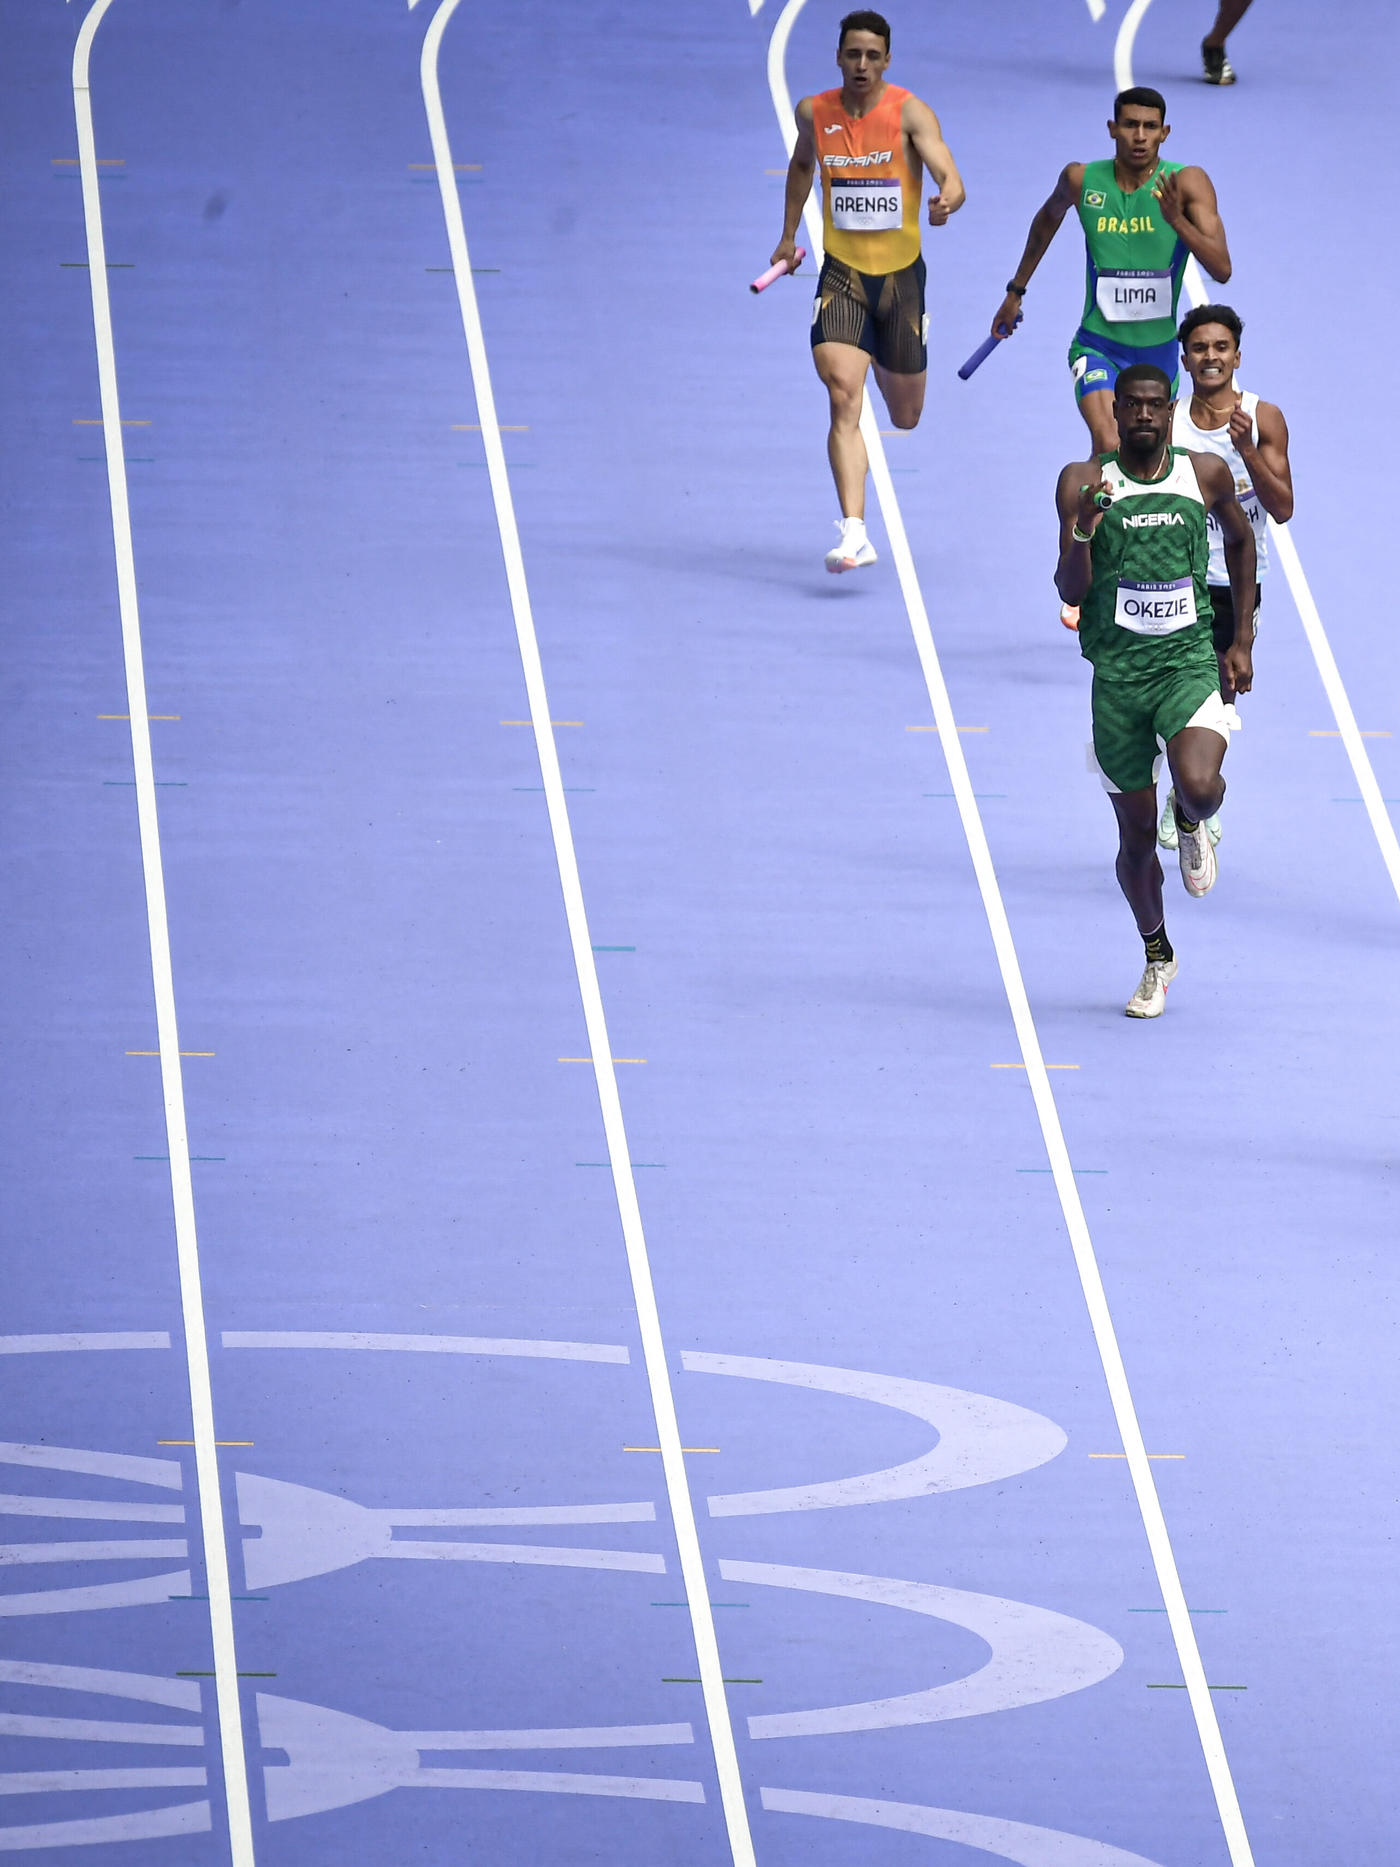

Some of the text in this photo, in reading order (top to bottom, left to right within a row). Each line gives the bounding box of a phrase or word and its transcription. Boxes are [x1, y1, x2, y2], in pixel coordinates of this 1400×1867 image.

[823, 151, 892, 167] ESPAÑA
[835, 196, 898, 212] ARENAS
[1097, 216, 1155, 234] BRASIL
[1115, 288, 1156, 303] LIMA
[1122, 512, 1185, 529] NIGERIA
[1124, 598, 1189, 618] OKEZIE
